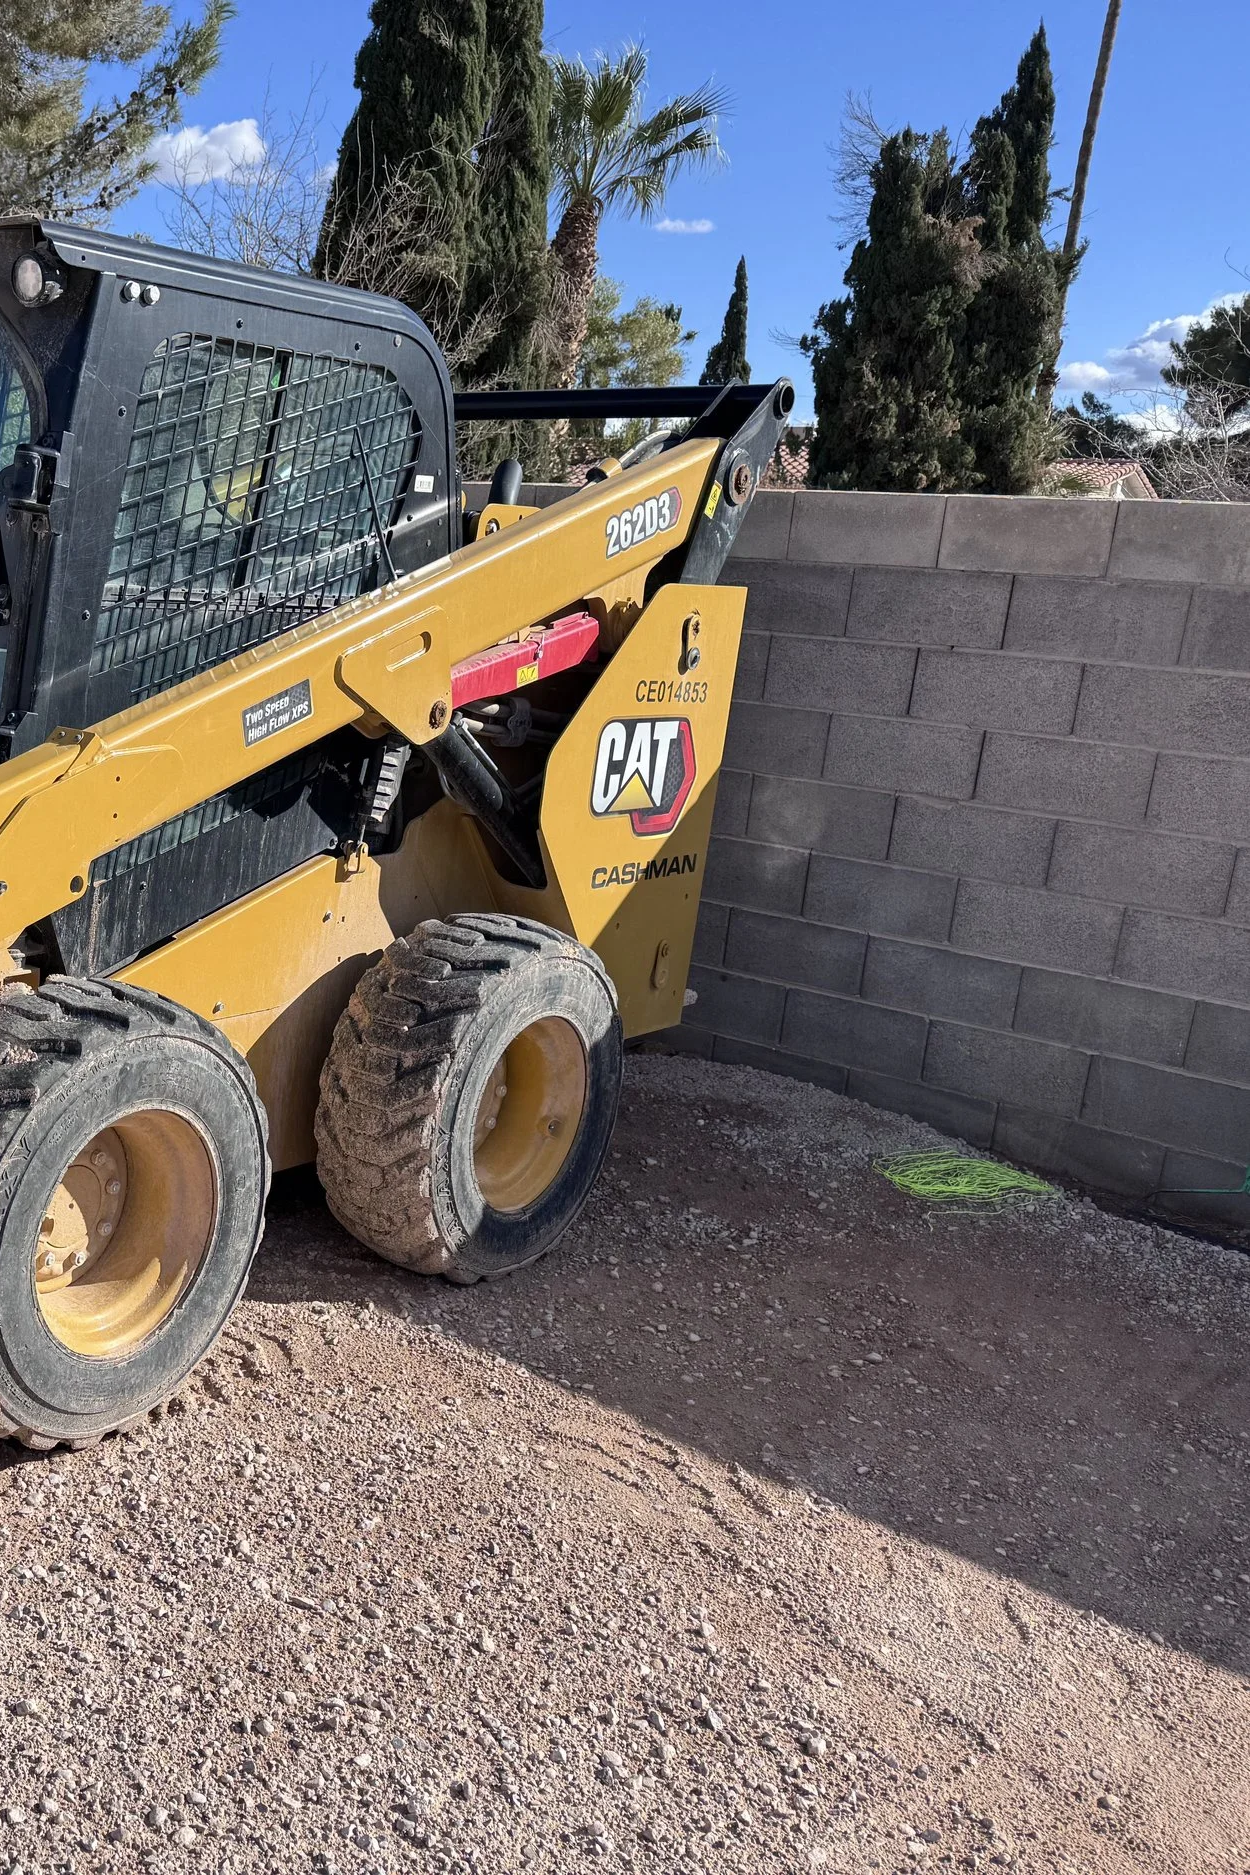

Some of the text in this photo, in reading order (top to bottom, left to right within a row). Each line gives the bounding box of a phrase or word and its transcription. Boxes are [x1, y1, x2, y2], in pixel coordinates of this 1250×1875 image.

[606, 492, 670, 556] 262D3
[636, 679, 708, 703] CE014853
[245, 696, 289, 727] TWO SPEED
[248, 700, 309, 743] HIGH FLOW XPS
[592, 720, 680, 814] CAT
[591, 854, 697, 889] CASHMAN
